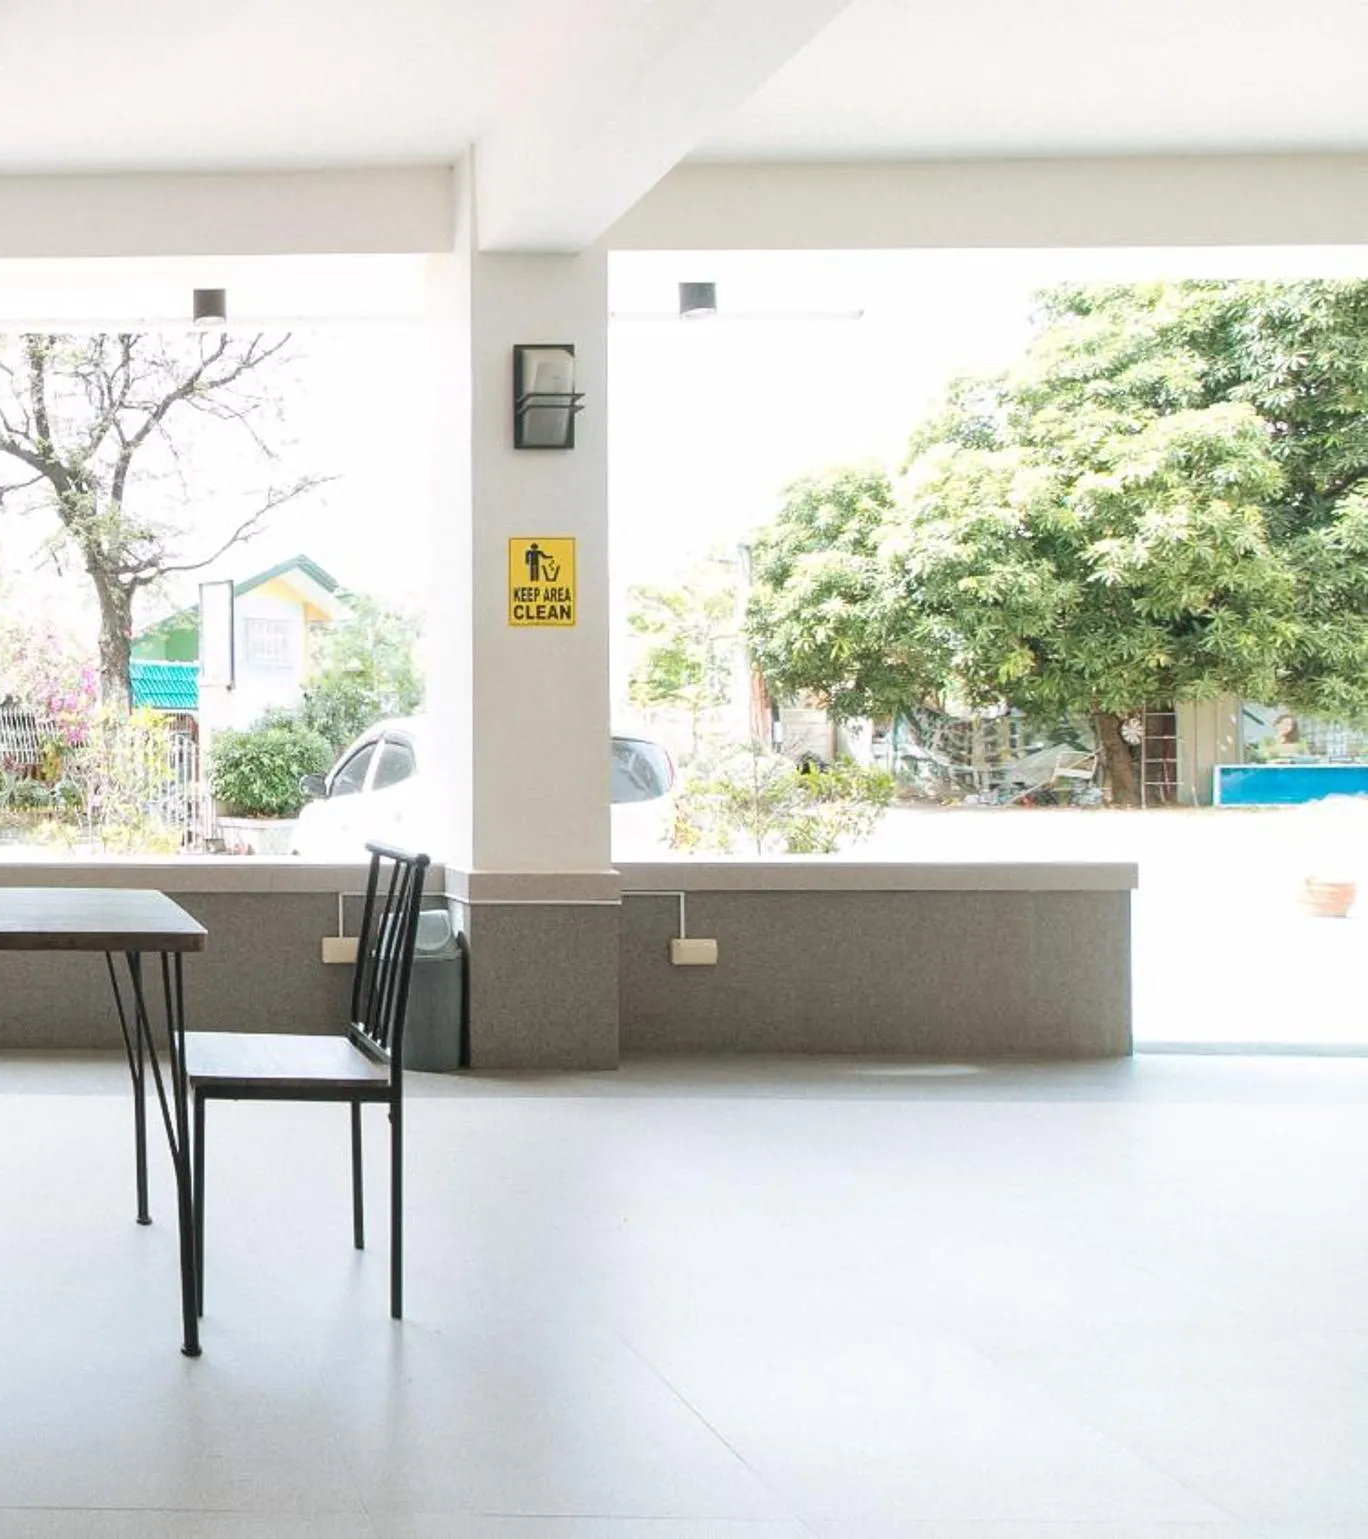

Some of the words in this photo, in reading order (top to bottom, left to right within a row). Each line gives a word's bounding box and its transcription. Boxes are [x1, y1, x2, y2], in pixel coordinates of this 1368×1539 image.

[513, 587, 541, 602] KEEP
[543, 587, 572, 602] AREA
[513, 604, 572, 620] CLEAN
